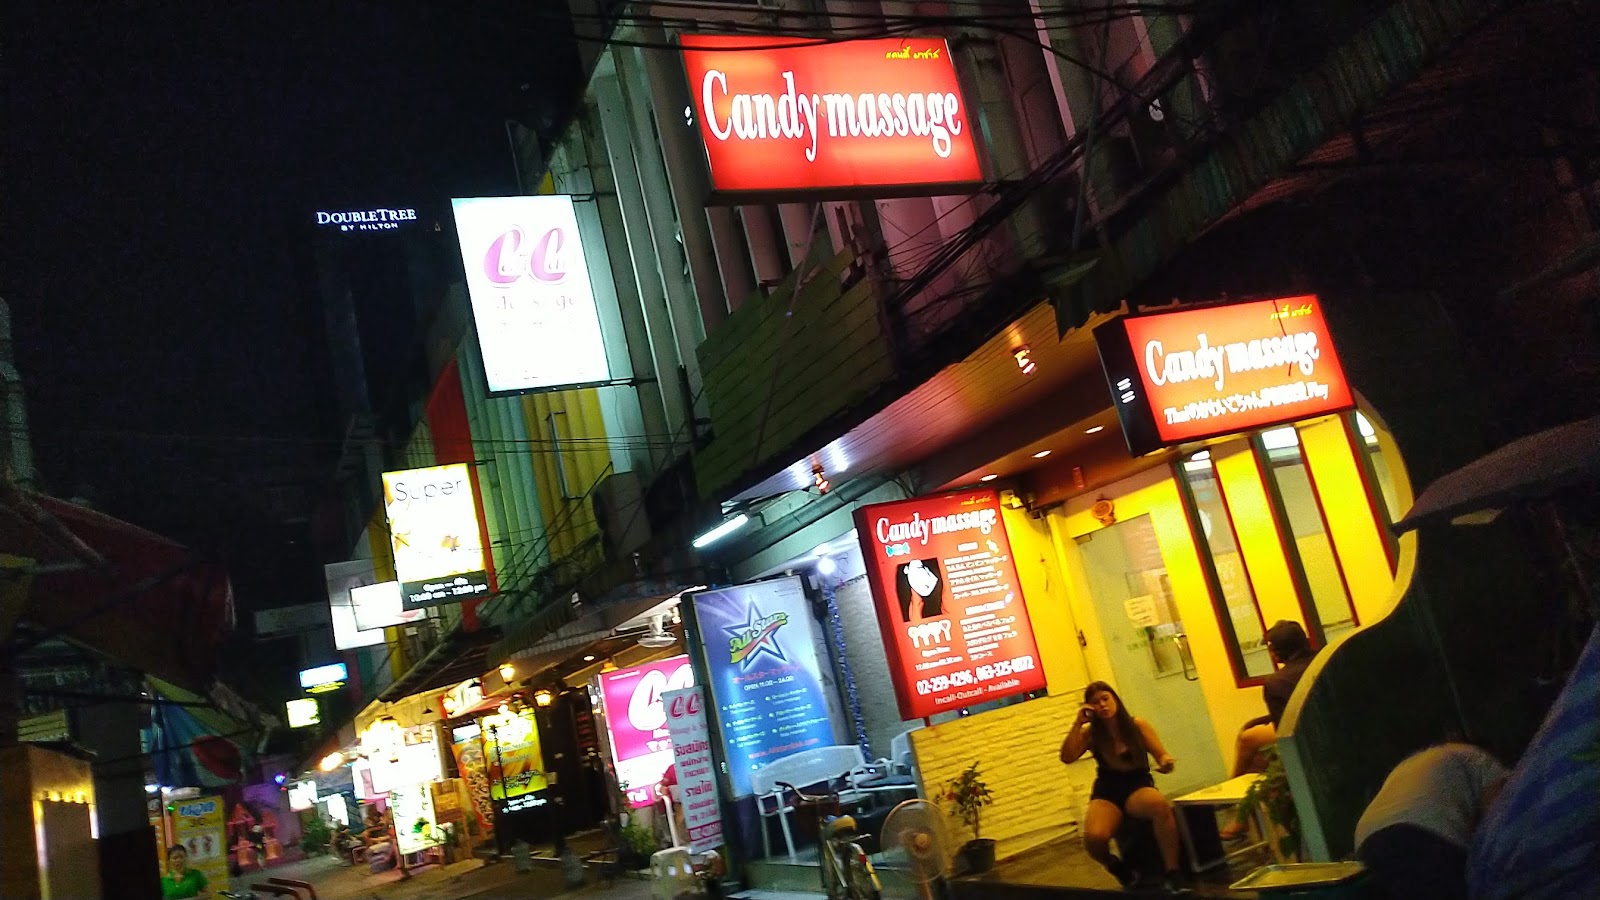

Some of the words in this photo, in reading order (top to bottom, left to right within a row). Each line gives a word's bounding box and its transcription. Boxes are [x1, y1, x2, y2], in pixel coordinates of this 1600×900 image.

[702, 69, 819, 162] Candy
[822, 92, 962, 158] massage
[360, 222, 398, 230] HILTON
[1145, 333, 1224, 391] Candy
[1224, 331, 1319, 376] massage
[395, 479, 462, 502] Super
[876, 512, 932, 545] Candy
[931, 508, 998, 534] massage
[744, 682, 759, 691] OPEN
[988, 679, 1020, 693] Available
